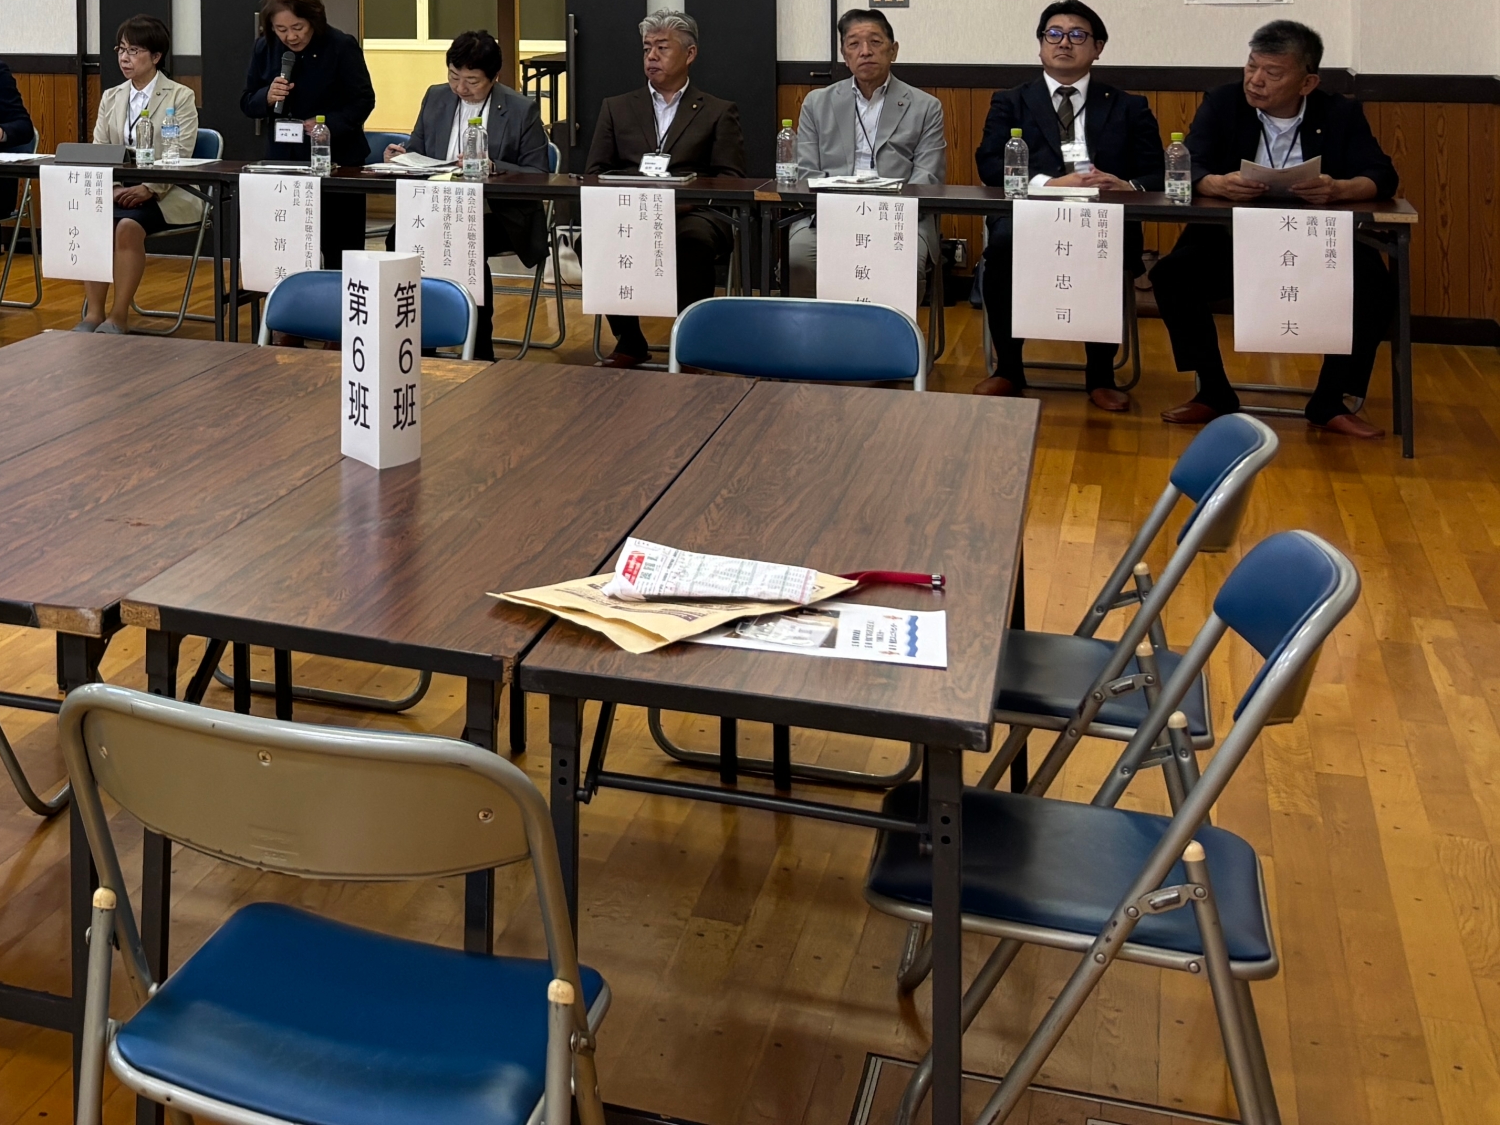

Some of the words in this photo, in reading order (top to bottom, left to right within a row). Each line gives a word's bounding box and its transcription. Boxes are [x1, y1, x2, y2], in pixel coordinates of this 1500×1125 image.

[84, 171, 92, 196] 副議長
[292, 180, 301, 207] 委員長
[431, 185, 440, 212] 委員長
[455, 187, 464, 223] 副委員長
[639, 193, 648, 221] 委員長
[304, 181, 314, 270] 議会広報広聴常任委員
[878, 201, 889, 221] 議員
[893, 202, 904, 251] 留萌市議会
[1080, 208, 1091, 228] 議員
[1097, 208, 1108, 259] 留萌市議会
[1306, 216, 1318, 237] 議員
[618, 194, 634, 300] 田村裕樹
[1055, 207, 1073, 323] 川村忠司
[1325, 216, 1337, 269] 留萌市議会
[1279, 215, 1299, 336] 米倉靖夫
[347, 277, 371, 430] 第6班
[392, 280, 417, 431] 第6班
